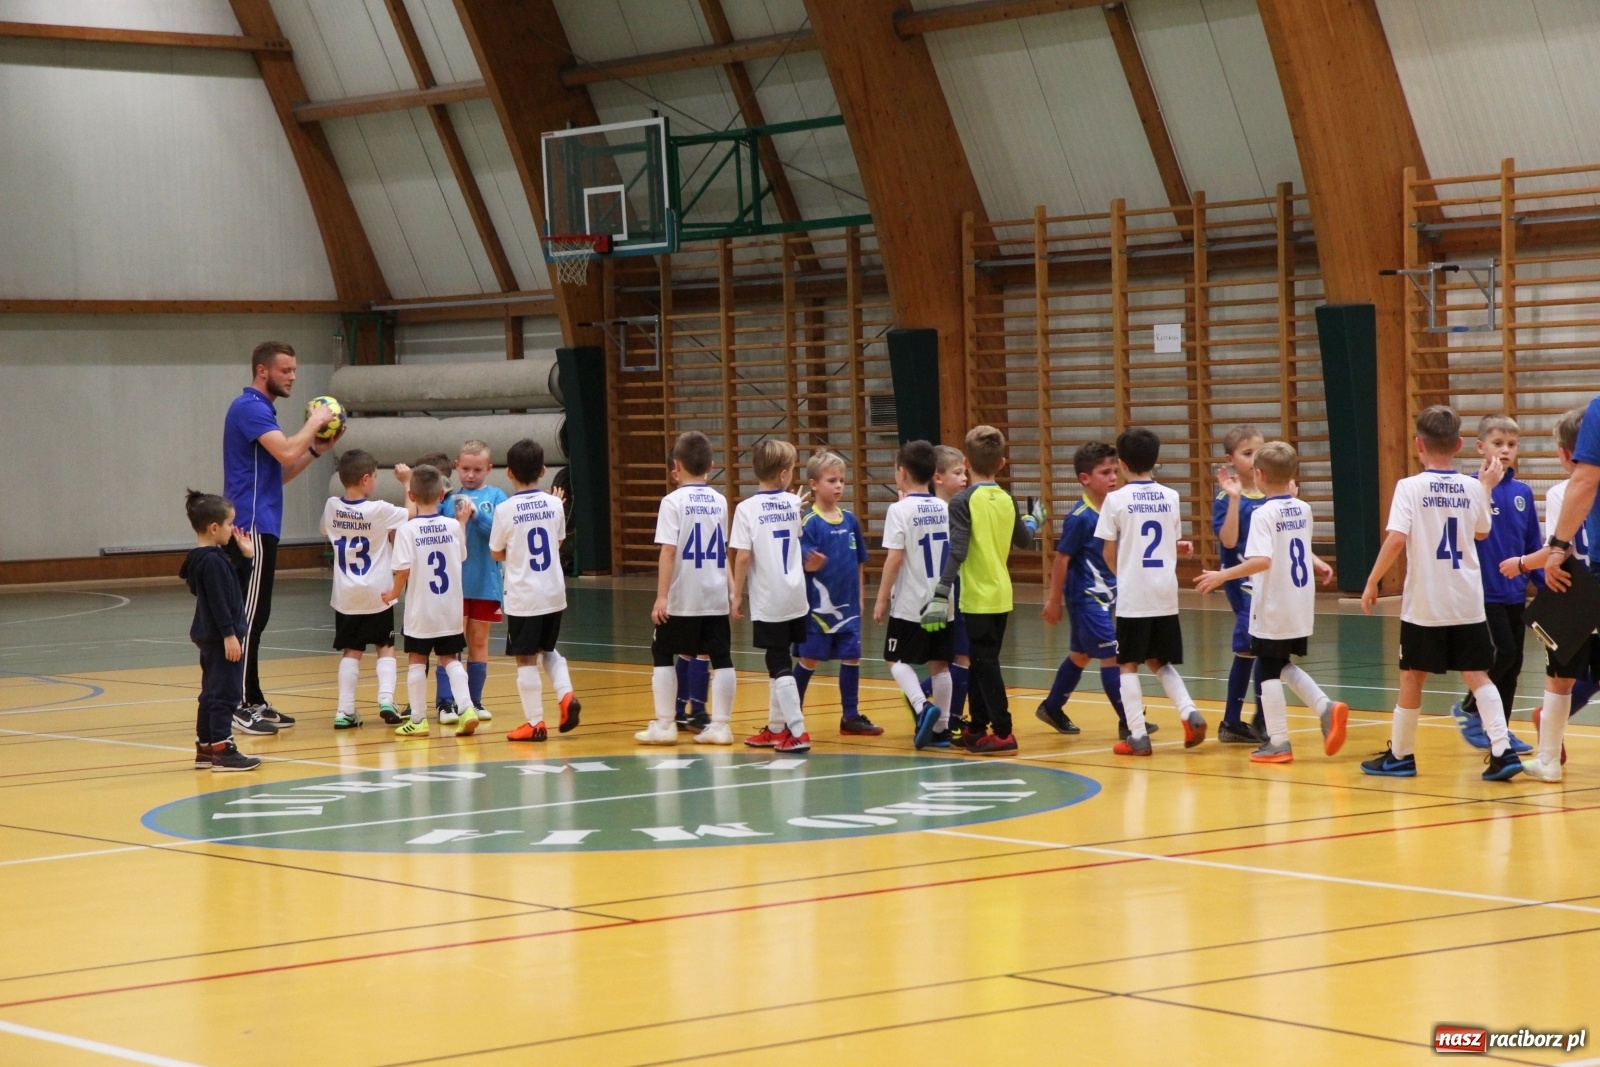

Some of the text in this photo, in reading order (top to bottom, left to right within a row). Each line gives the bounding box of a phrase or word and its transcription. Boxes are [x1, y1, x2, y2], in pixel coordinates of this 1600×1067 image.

[689, 493, 716, 504] FORTECA
[1132, 491, 1165, 501] FORTECA
[1429, 482, 1465, 494] FORTECA
[336, 509, 364, 521] FORTECA
[517, 499, 548, 512] FORTECA
[762, 501, 792, 511] FORTECA
[917, 503, 945, 514] FORTECA
[419, 524, 448, 535] FORTECA
[1436, 517, 1463, 569] 4
[333, 535, 372, 576] 13
[526, 527, 552, 572] 9
[682, 522, 727, 569] 44
[772, 529, 791, 575] 7
[918, 531, 949, 579] 17
[1141, 520, 1164, 568] 2
[427, 550, 450, 595] 3
[1289, 537, 1308, 588] 8
[888, 638, 898, 652] 17
